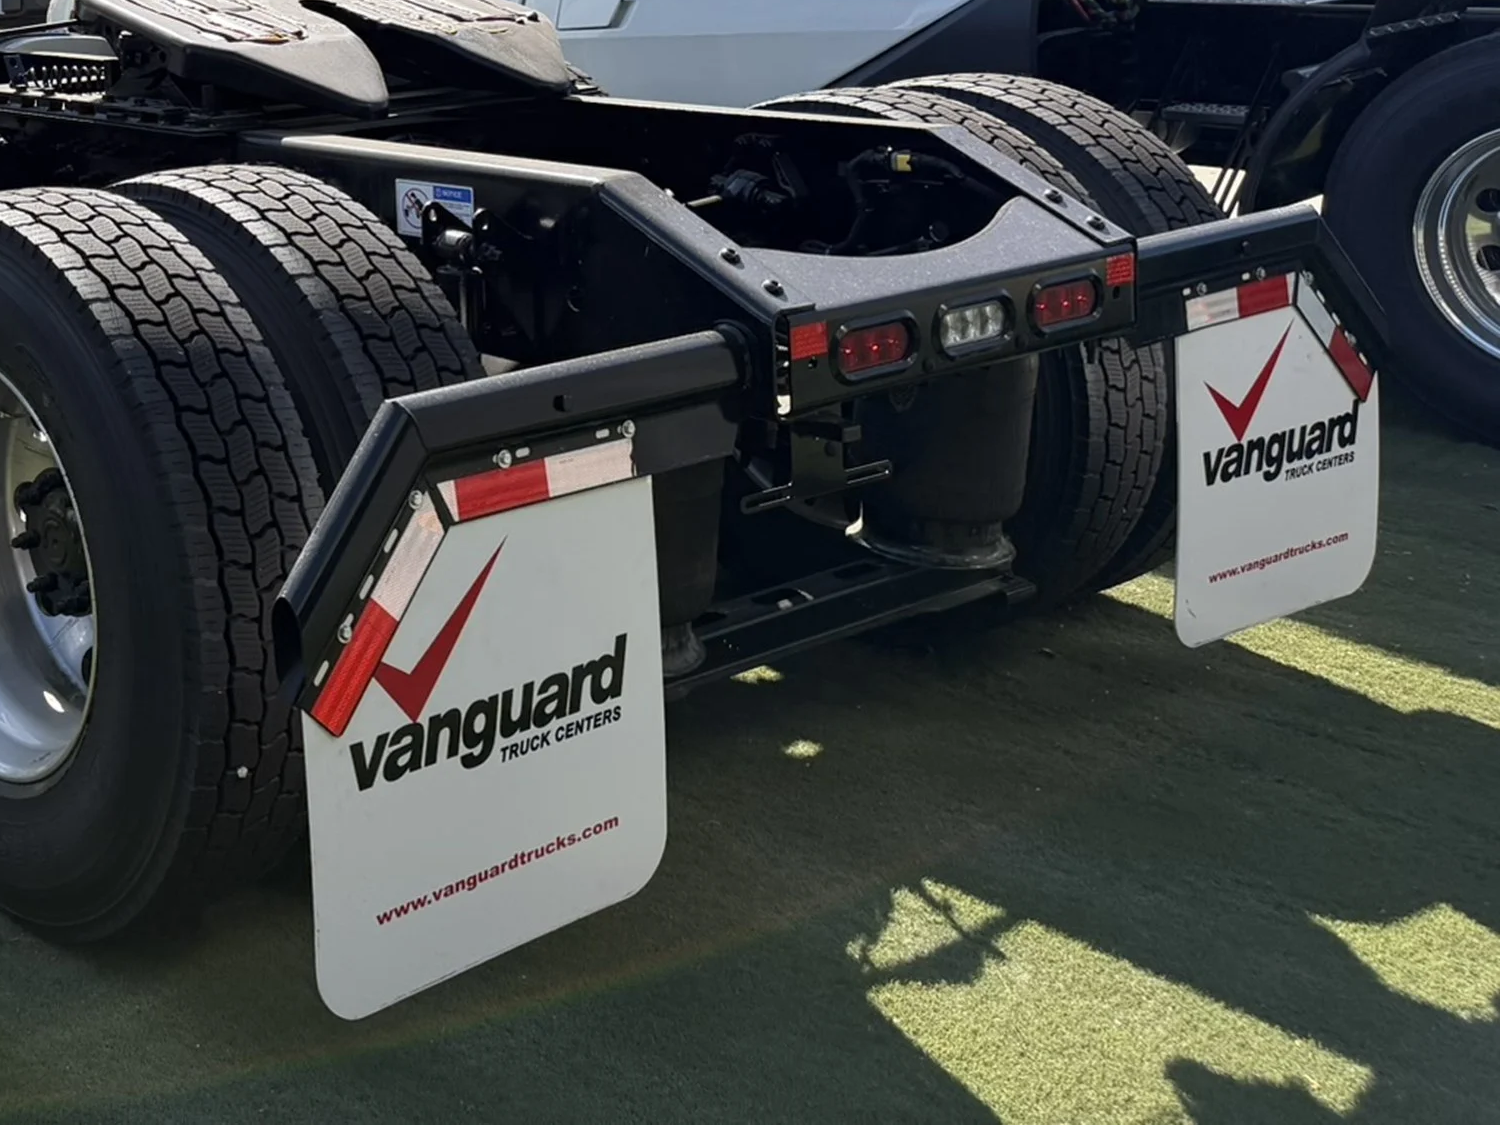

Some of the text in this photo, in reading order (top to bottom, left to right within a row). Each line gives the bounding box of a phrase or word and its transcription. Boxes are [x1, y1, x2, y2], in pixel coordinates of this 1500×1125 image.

[1202, 398, 1360, 487] vanguard
[1284, 450, 1356, 482] TRUCK CENTERS
[1208, 531, 1349, 584] www.vanguardtrucks.com
[349, 632, 628, 792] vanguard
[500, 705, 622, 763] TRUCK CENTERS
[375, 816, 620, 926] www.vanguardtrucks.com
